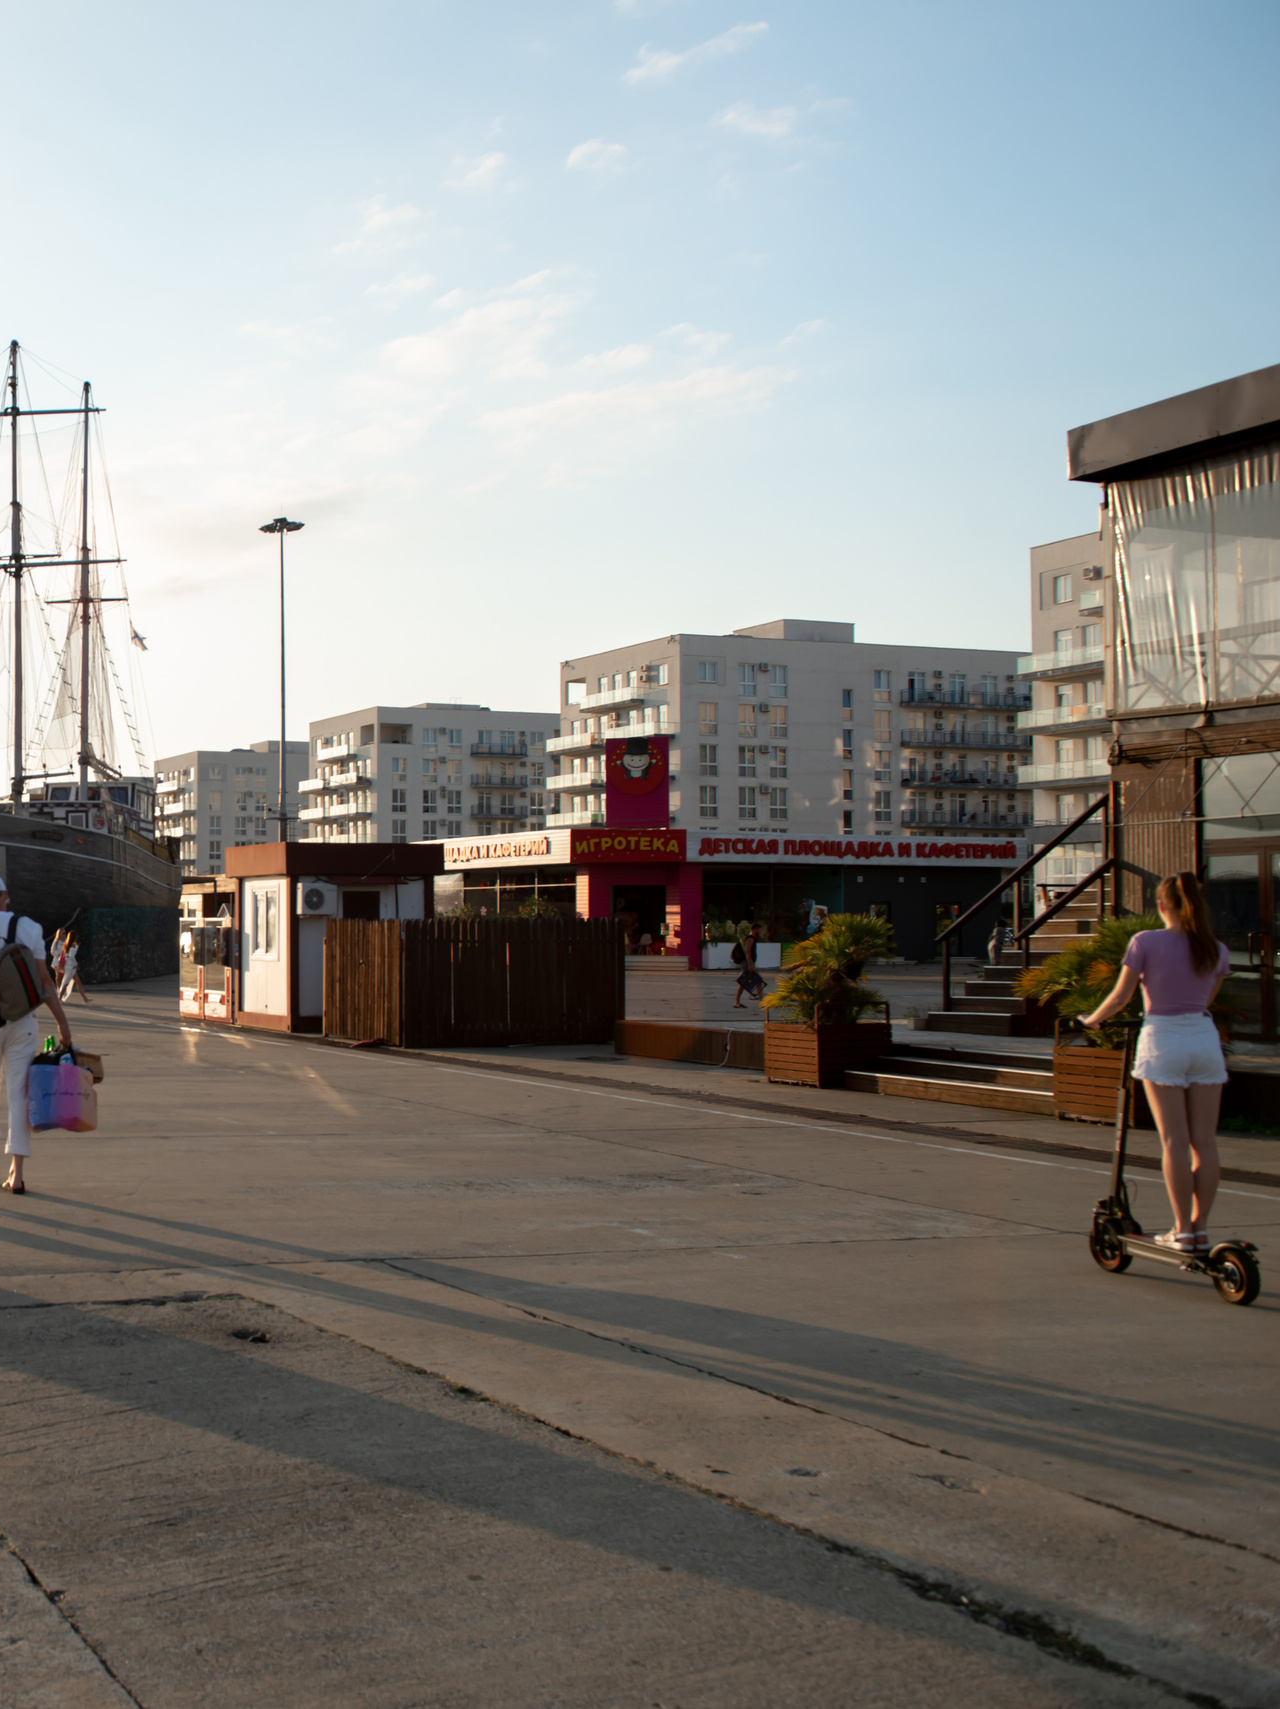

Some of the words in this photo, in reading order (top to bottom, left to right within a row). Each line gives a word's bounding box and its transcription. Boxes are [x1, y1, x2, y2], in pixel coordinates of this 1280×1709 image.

[480, 844, 489, 859] И
[489, 836, 549, 858] КАФЕТЕРИЙ
[576, 836, 680, 855] ИГРОТЕКА
[699, 837, 779, 856] ДЕТСКАЯ
[783, 839, 895, 859] ПЛОЩАДКА
[898, 842, 912, 857] И
[915, 841, 1017, 859] КАФЕТЕРИЙ
